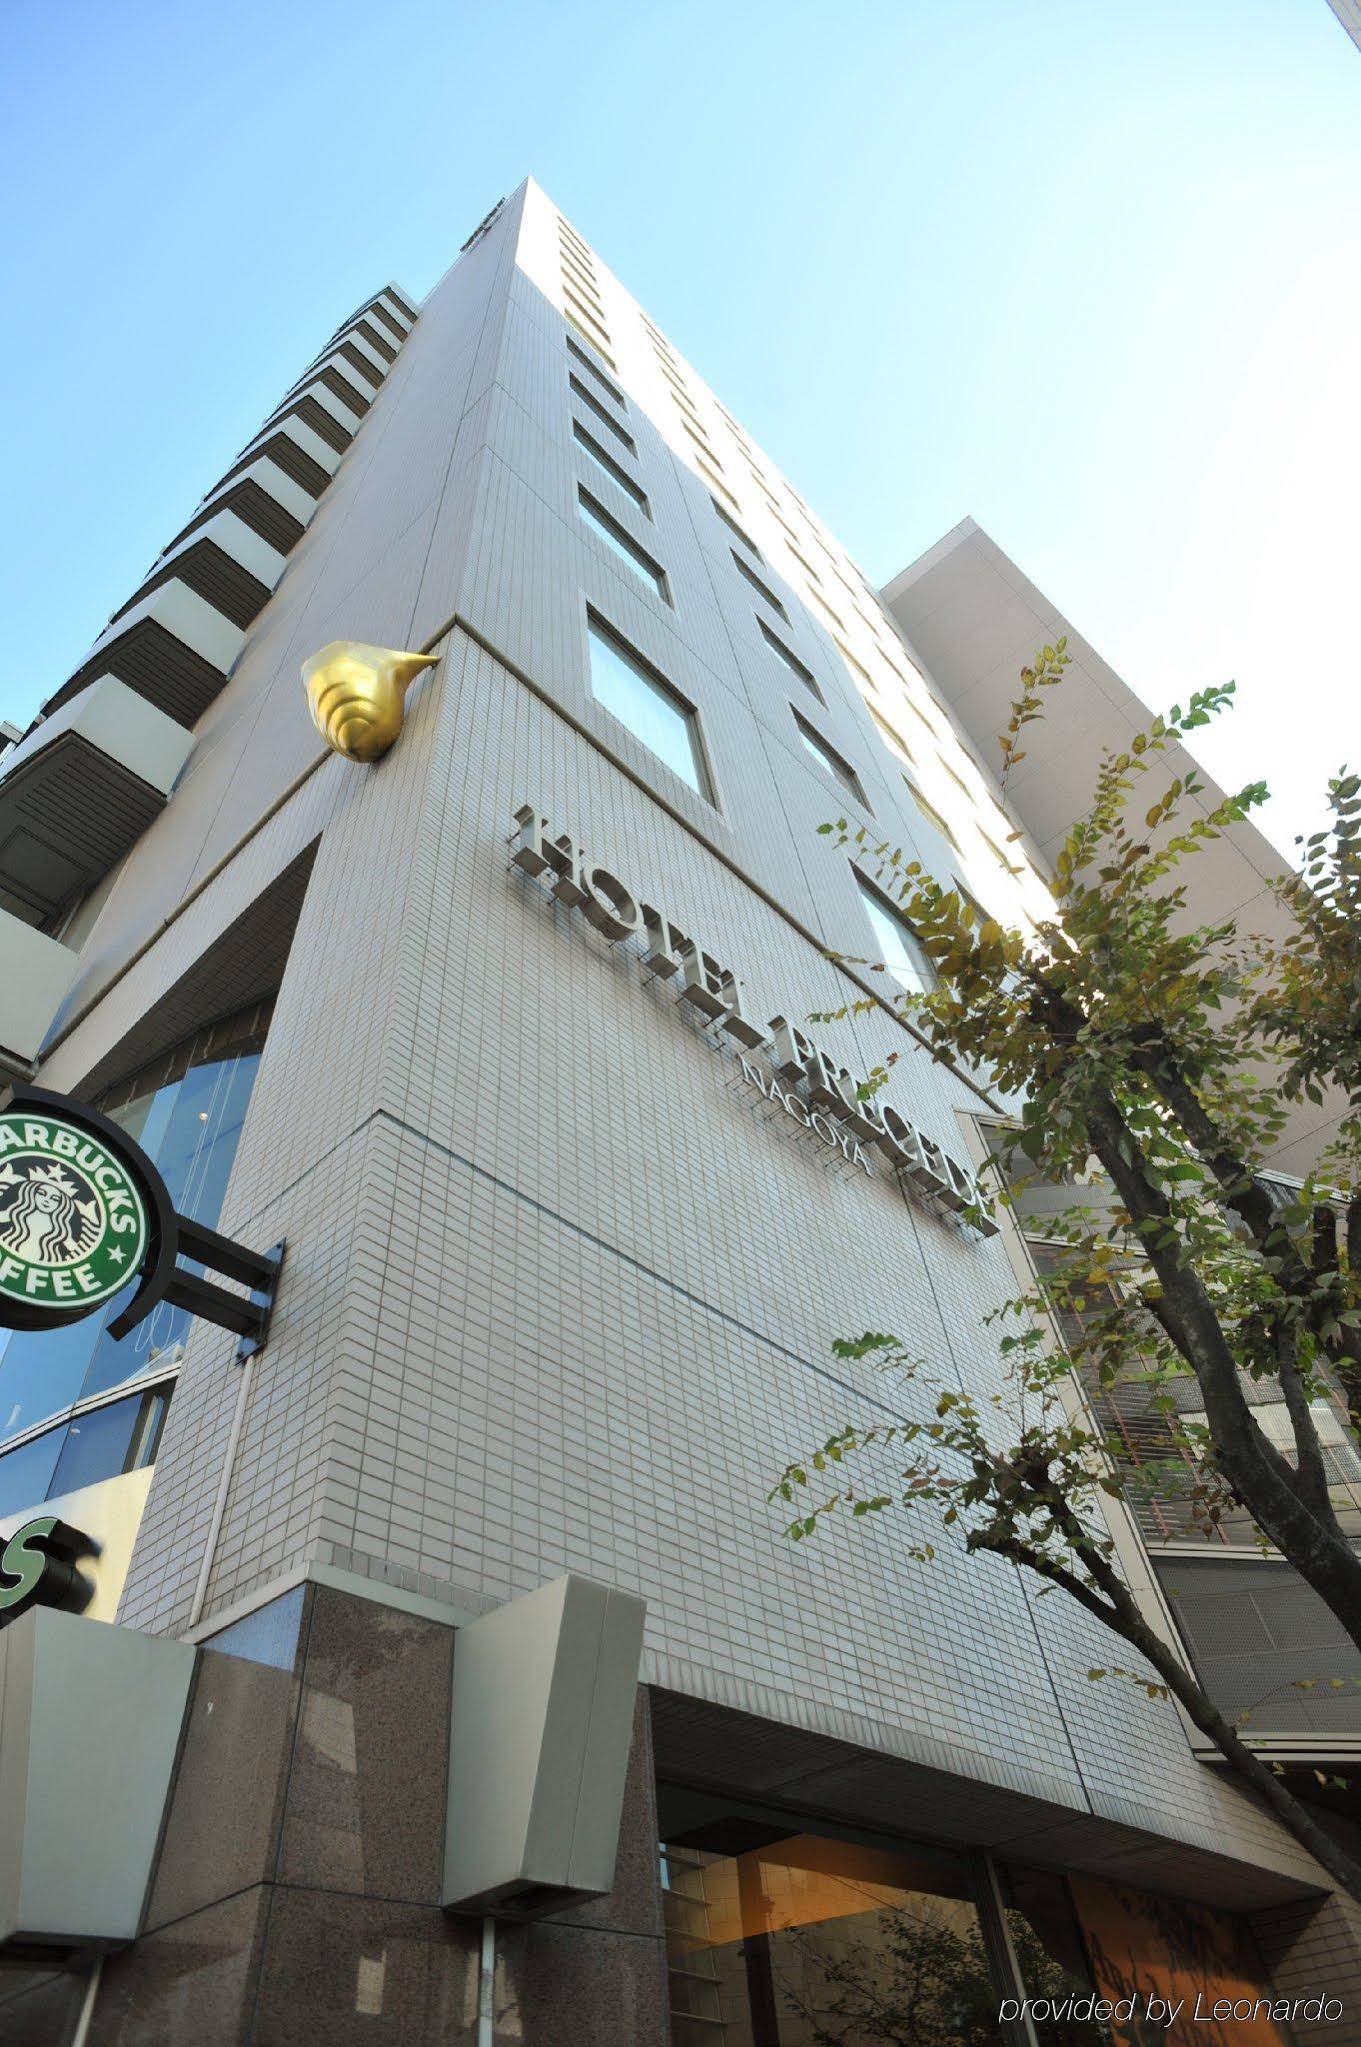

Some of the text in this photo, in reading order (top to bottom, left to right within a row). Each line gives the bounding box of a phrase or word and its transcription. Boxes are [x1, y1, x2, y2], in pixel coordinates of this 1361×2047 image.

[512, 804, 1001, 1238] HOTEL PRECEDE
[736, 1052, 873, 1178] NAGOYA
[0, 1253, 101, 1298] FFEE
